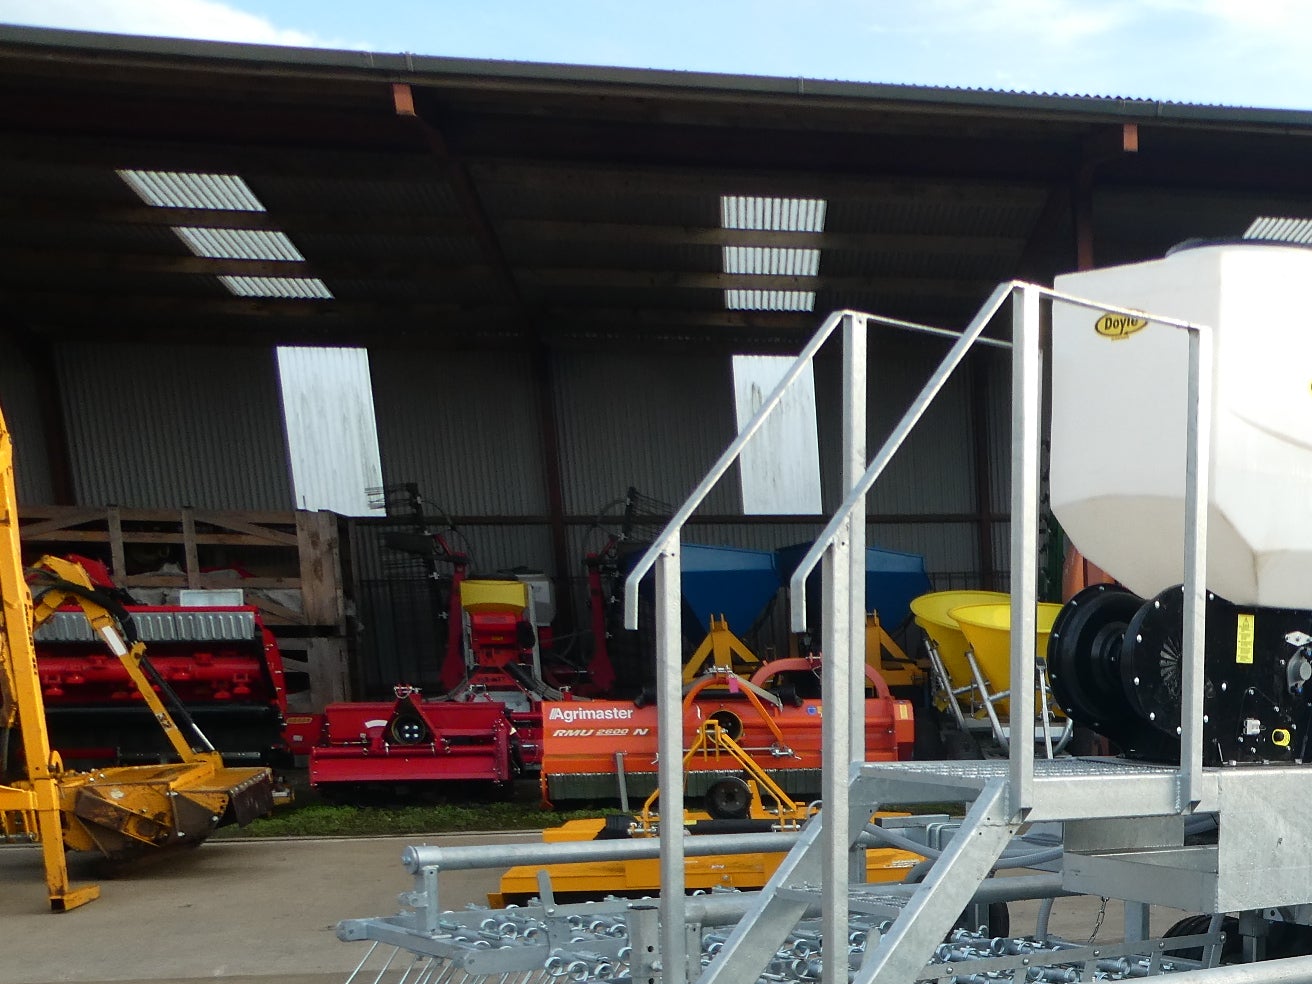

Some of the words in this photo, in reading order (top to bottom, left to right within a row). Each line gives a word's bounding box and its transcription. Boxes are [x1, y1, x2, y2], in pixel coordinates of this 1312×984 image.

[549, 707, 634, 723] Agrimaster
[553, 729, 595, 737] RMU
[596, 728, 628, 736] 2600
[633, 728, 649, 736] N
